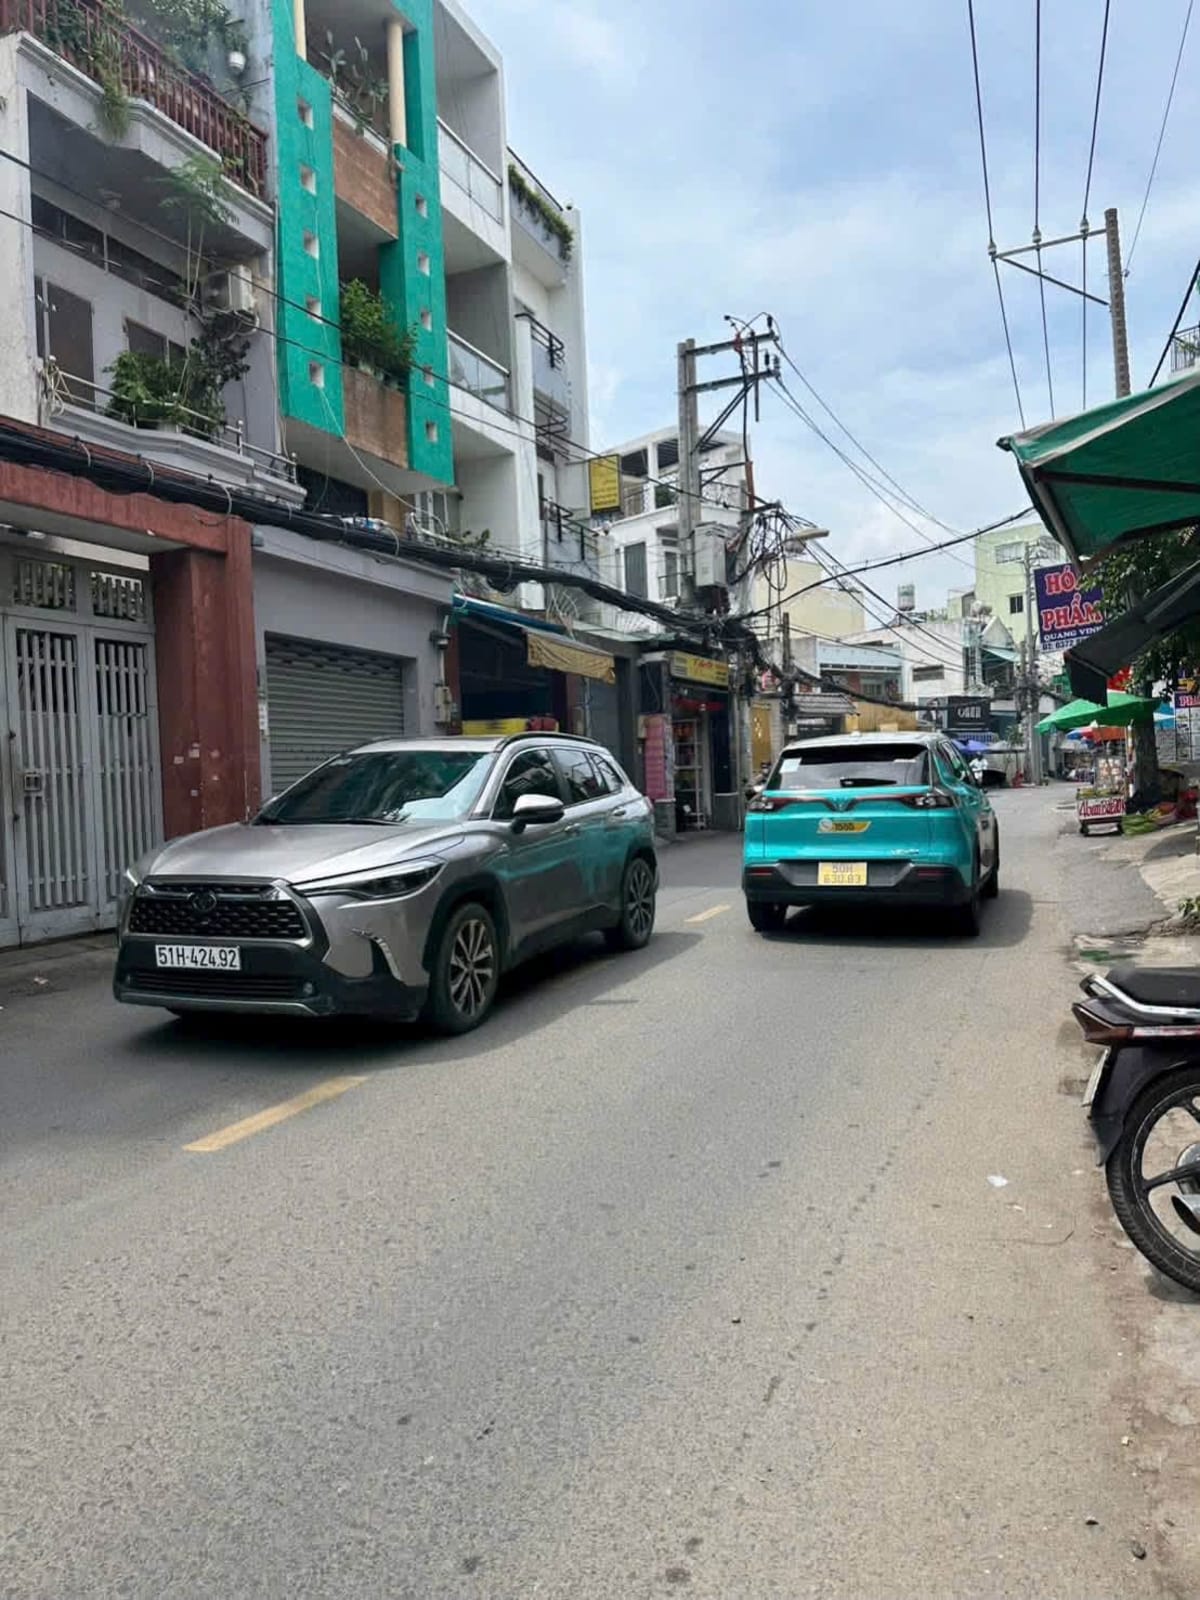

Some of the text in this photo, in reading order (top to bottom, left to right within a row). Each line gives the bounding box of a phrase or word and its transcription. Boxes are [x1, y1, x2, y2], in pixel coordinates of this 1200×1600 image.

[1044, 565, 1080, 595] HÓ
[1043, 629, 1077, 641] QUANG
[158, 946, 238, 968] 51H-424.92
